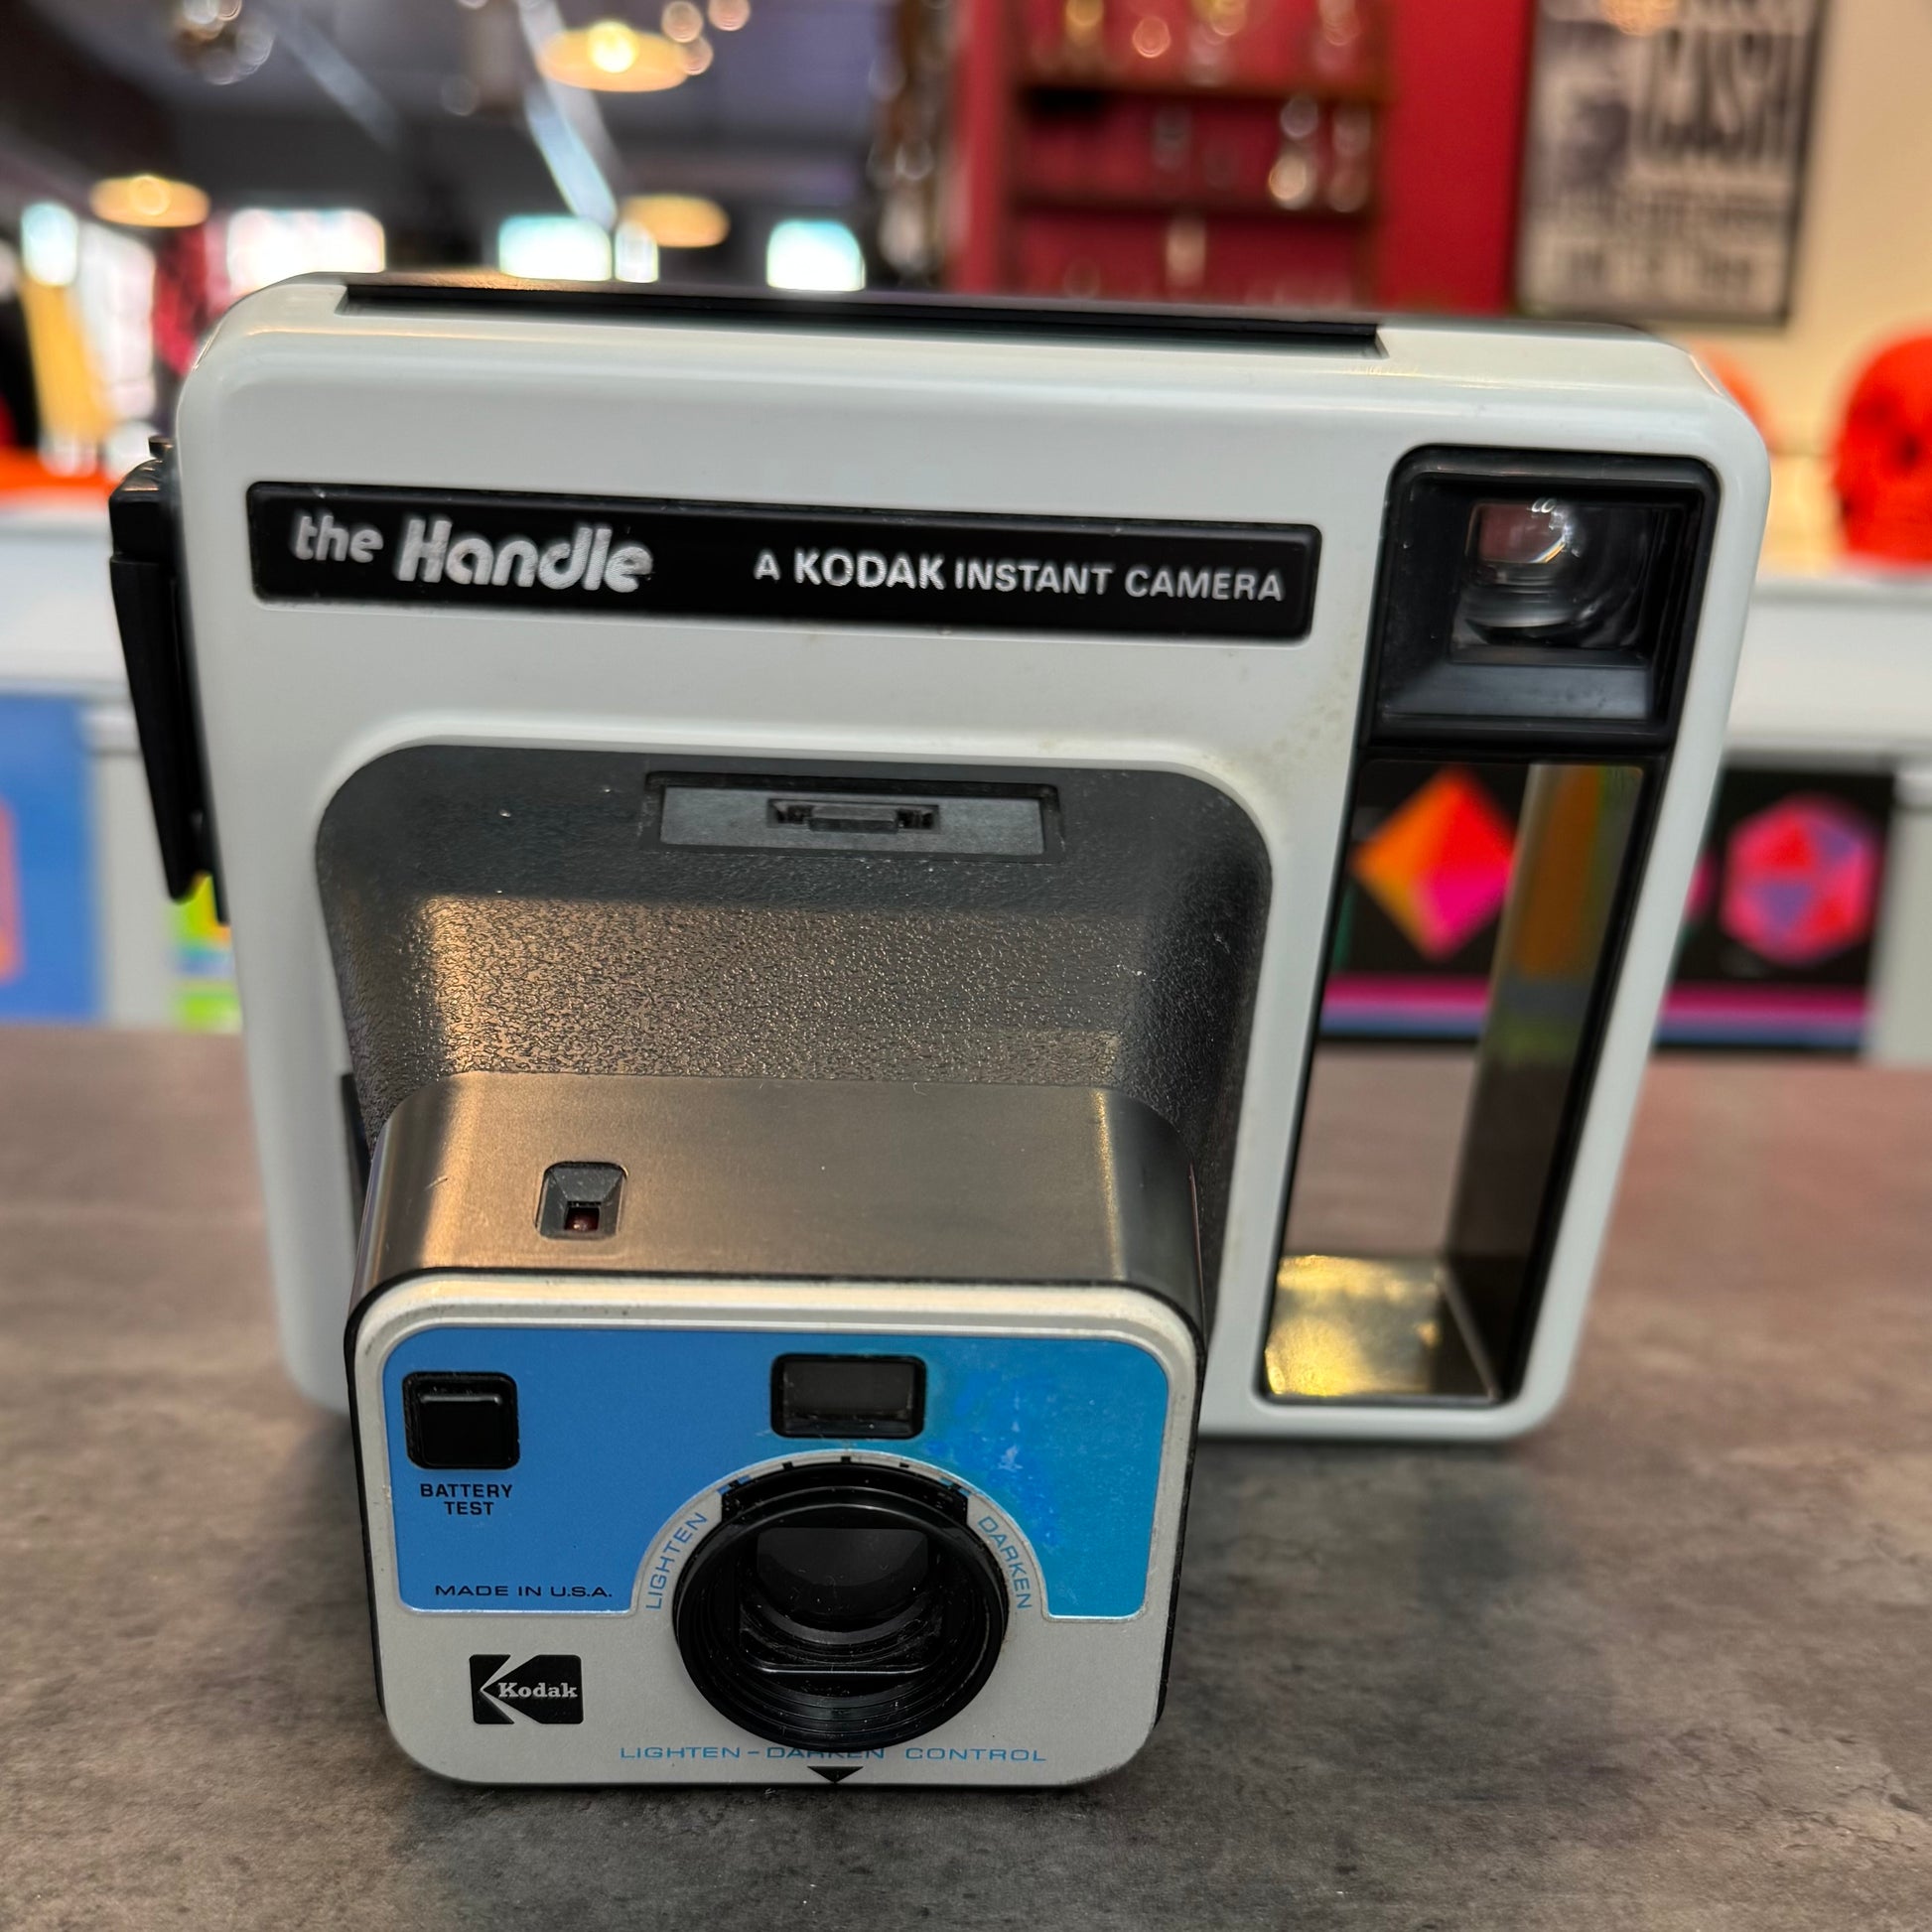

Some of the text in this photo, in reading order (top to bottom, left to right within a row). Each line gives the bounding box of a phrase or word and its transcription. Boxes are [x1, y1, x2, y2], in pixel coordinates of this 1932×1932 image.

[294, 513, 654, 593] the Handle
[754, 550, 1285, 602] A KODAK INSTANT CAMERA
[420, 1483, 512, 1498] BATTERY
[444, 1501, 494, 1515] TEST
[645, 1512, 708, 1609] LIGHTEN
[978, 1516, 1033, 1609] DARKEN
[435, 1585, 613, 1597] MADE IN U.S.A.
[497, 1682, 578, 1698] Kodak
[904, 1747, 1047, 1761] CONTROL
